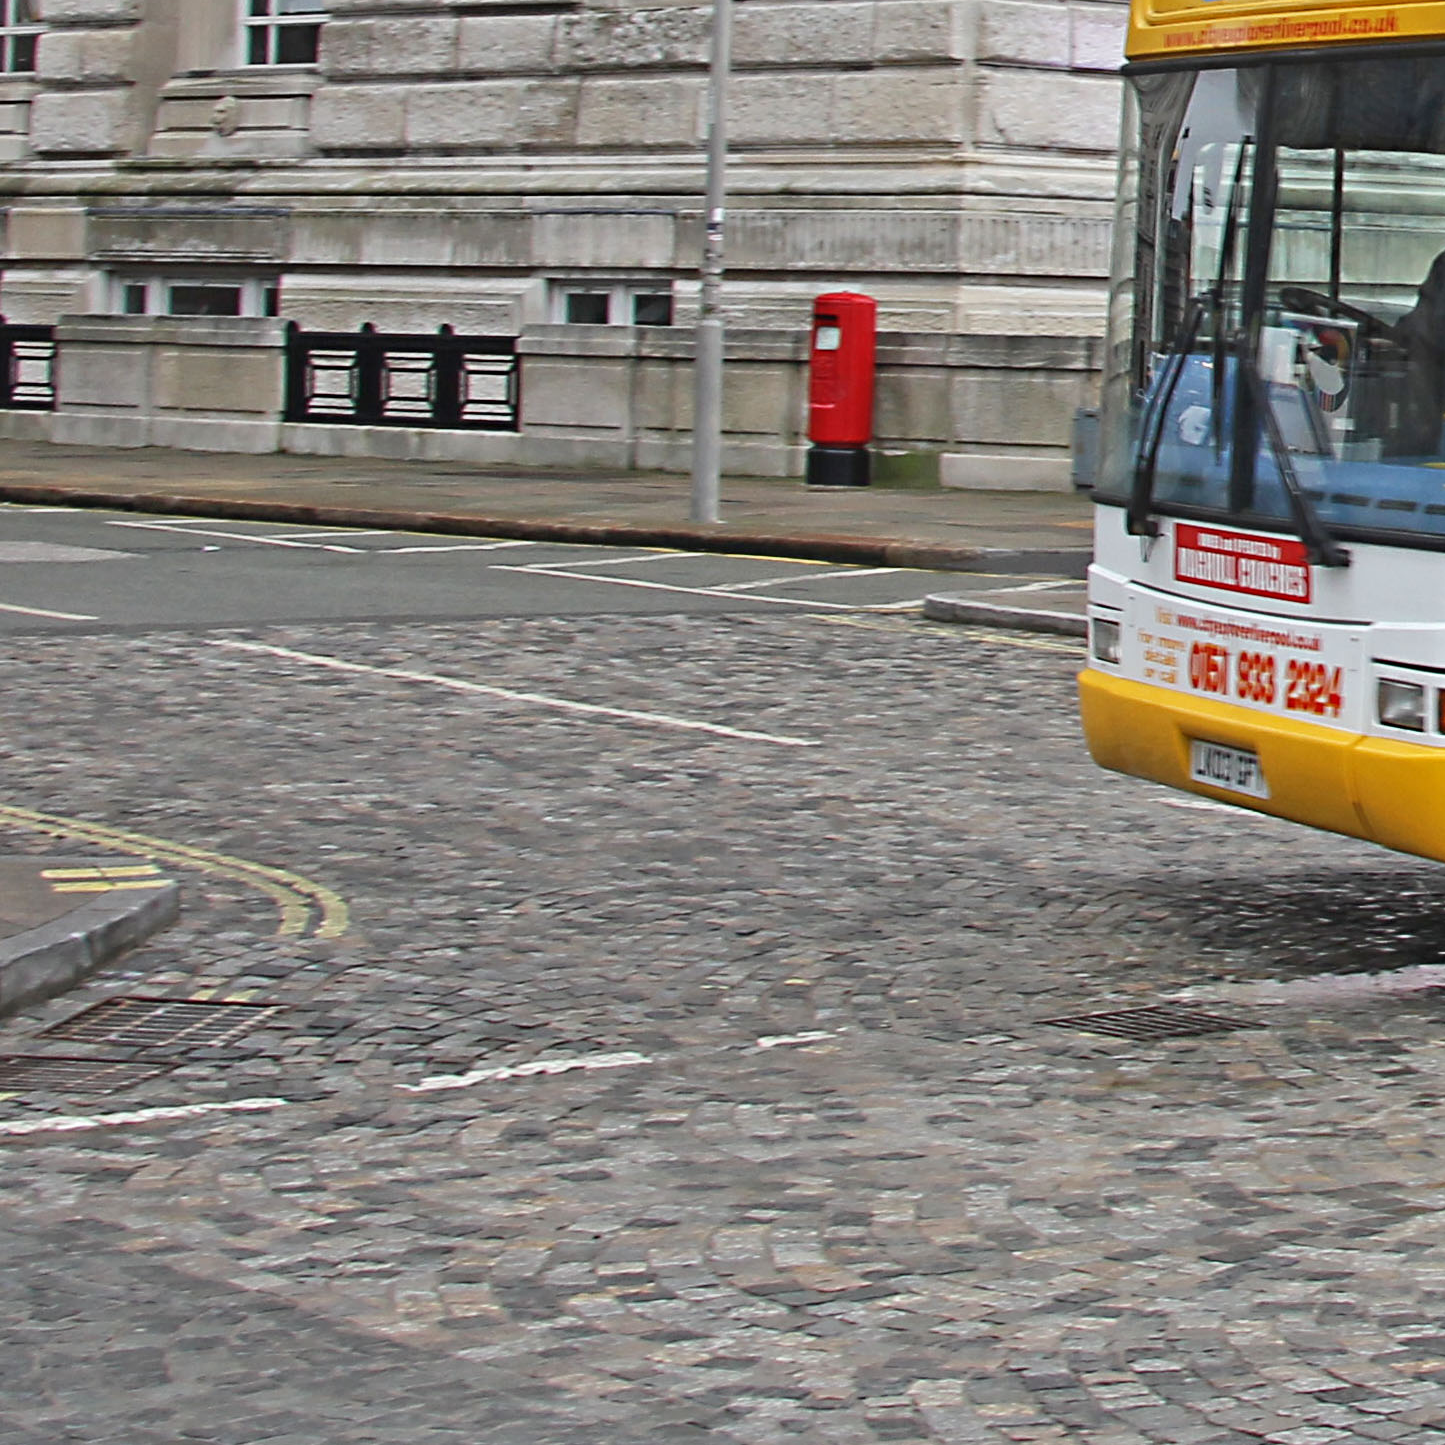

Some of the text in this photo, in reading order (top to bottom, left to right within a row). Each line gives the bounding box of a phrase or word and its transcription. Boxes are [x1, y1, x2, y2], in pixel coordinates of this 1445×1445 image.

[1189, 640, 1342, 718] 0151 933 2324
